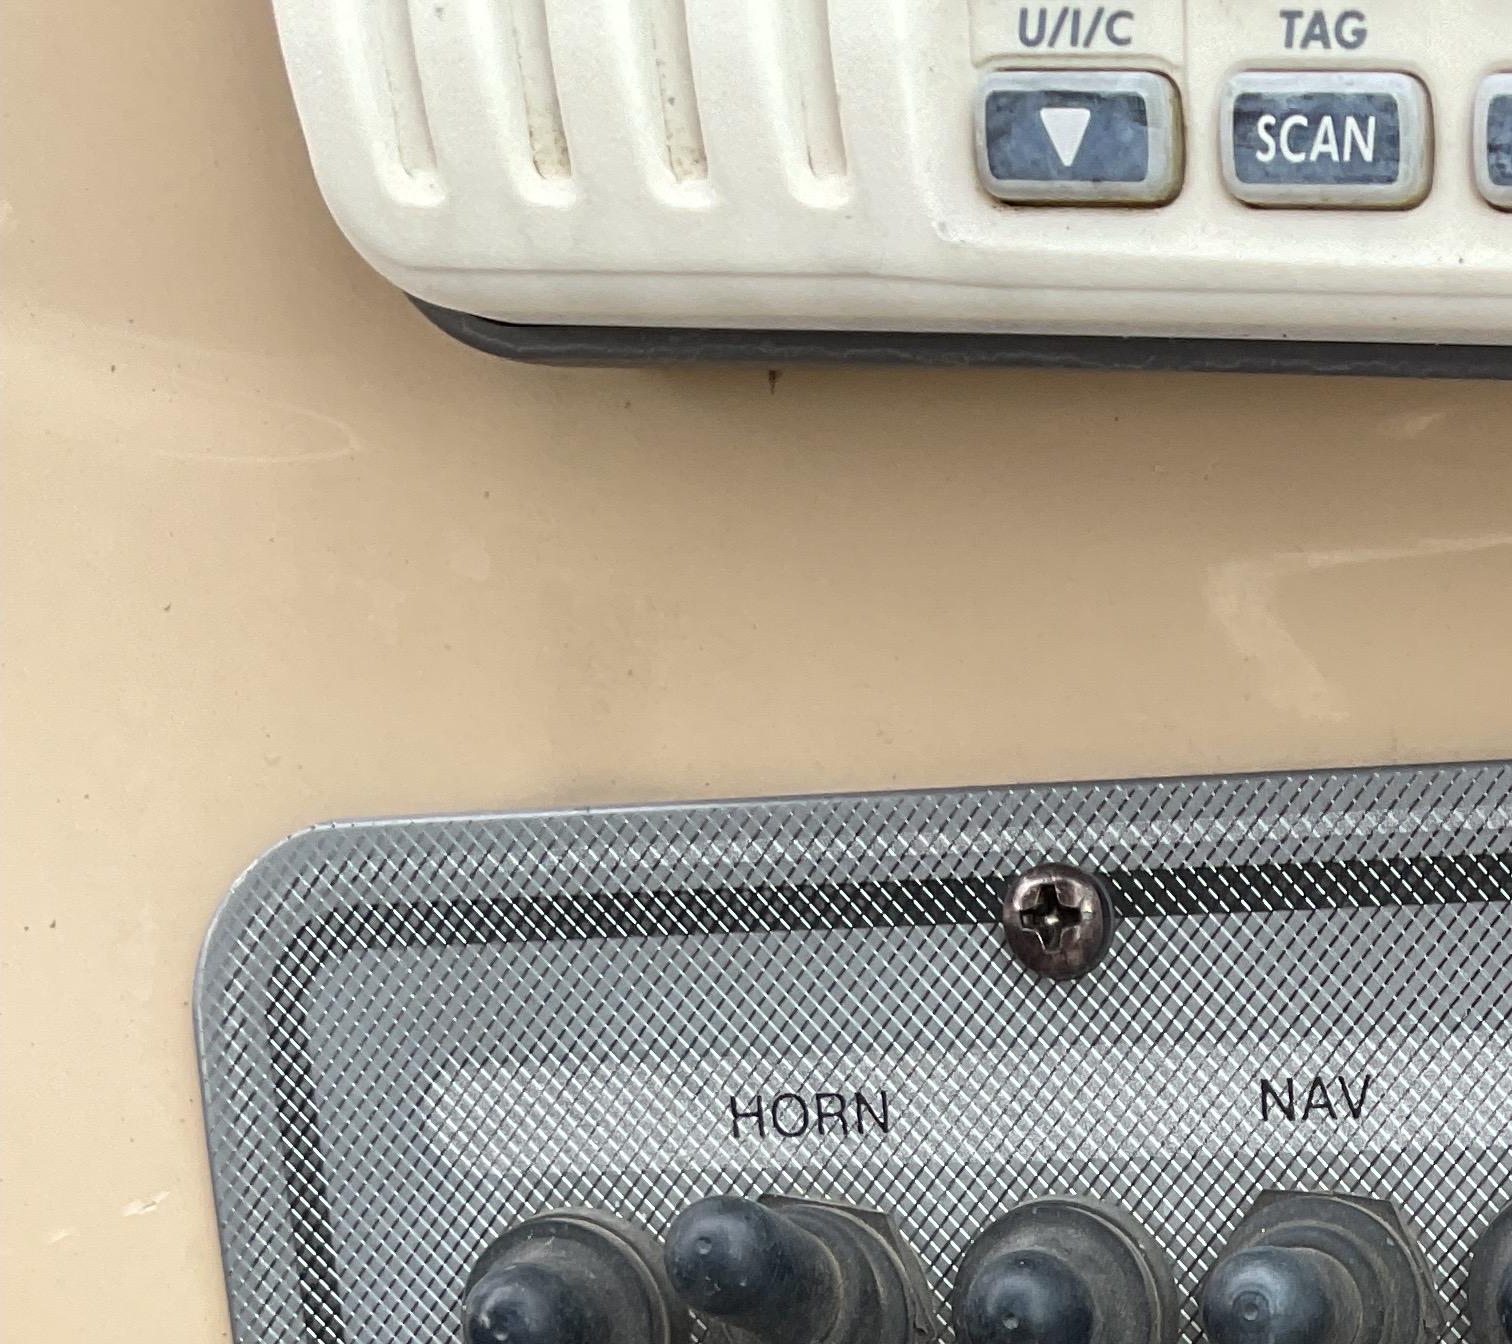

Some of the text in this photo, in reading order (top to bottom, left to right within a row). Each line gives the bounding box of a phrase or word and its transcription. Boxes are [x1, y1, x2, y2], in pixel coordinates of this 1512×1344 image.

[1018, 7, 1134, 48] U/I/C
[1280, 10, 1368, 49] TAG
[1256, 114, 1376, 163] SCAN
[730, 1091, 891, 1140] HORN
[1260, 1075, 1372, 1124] NAV
